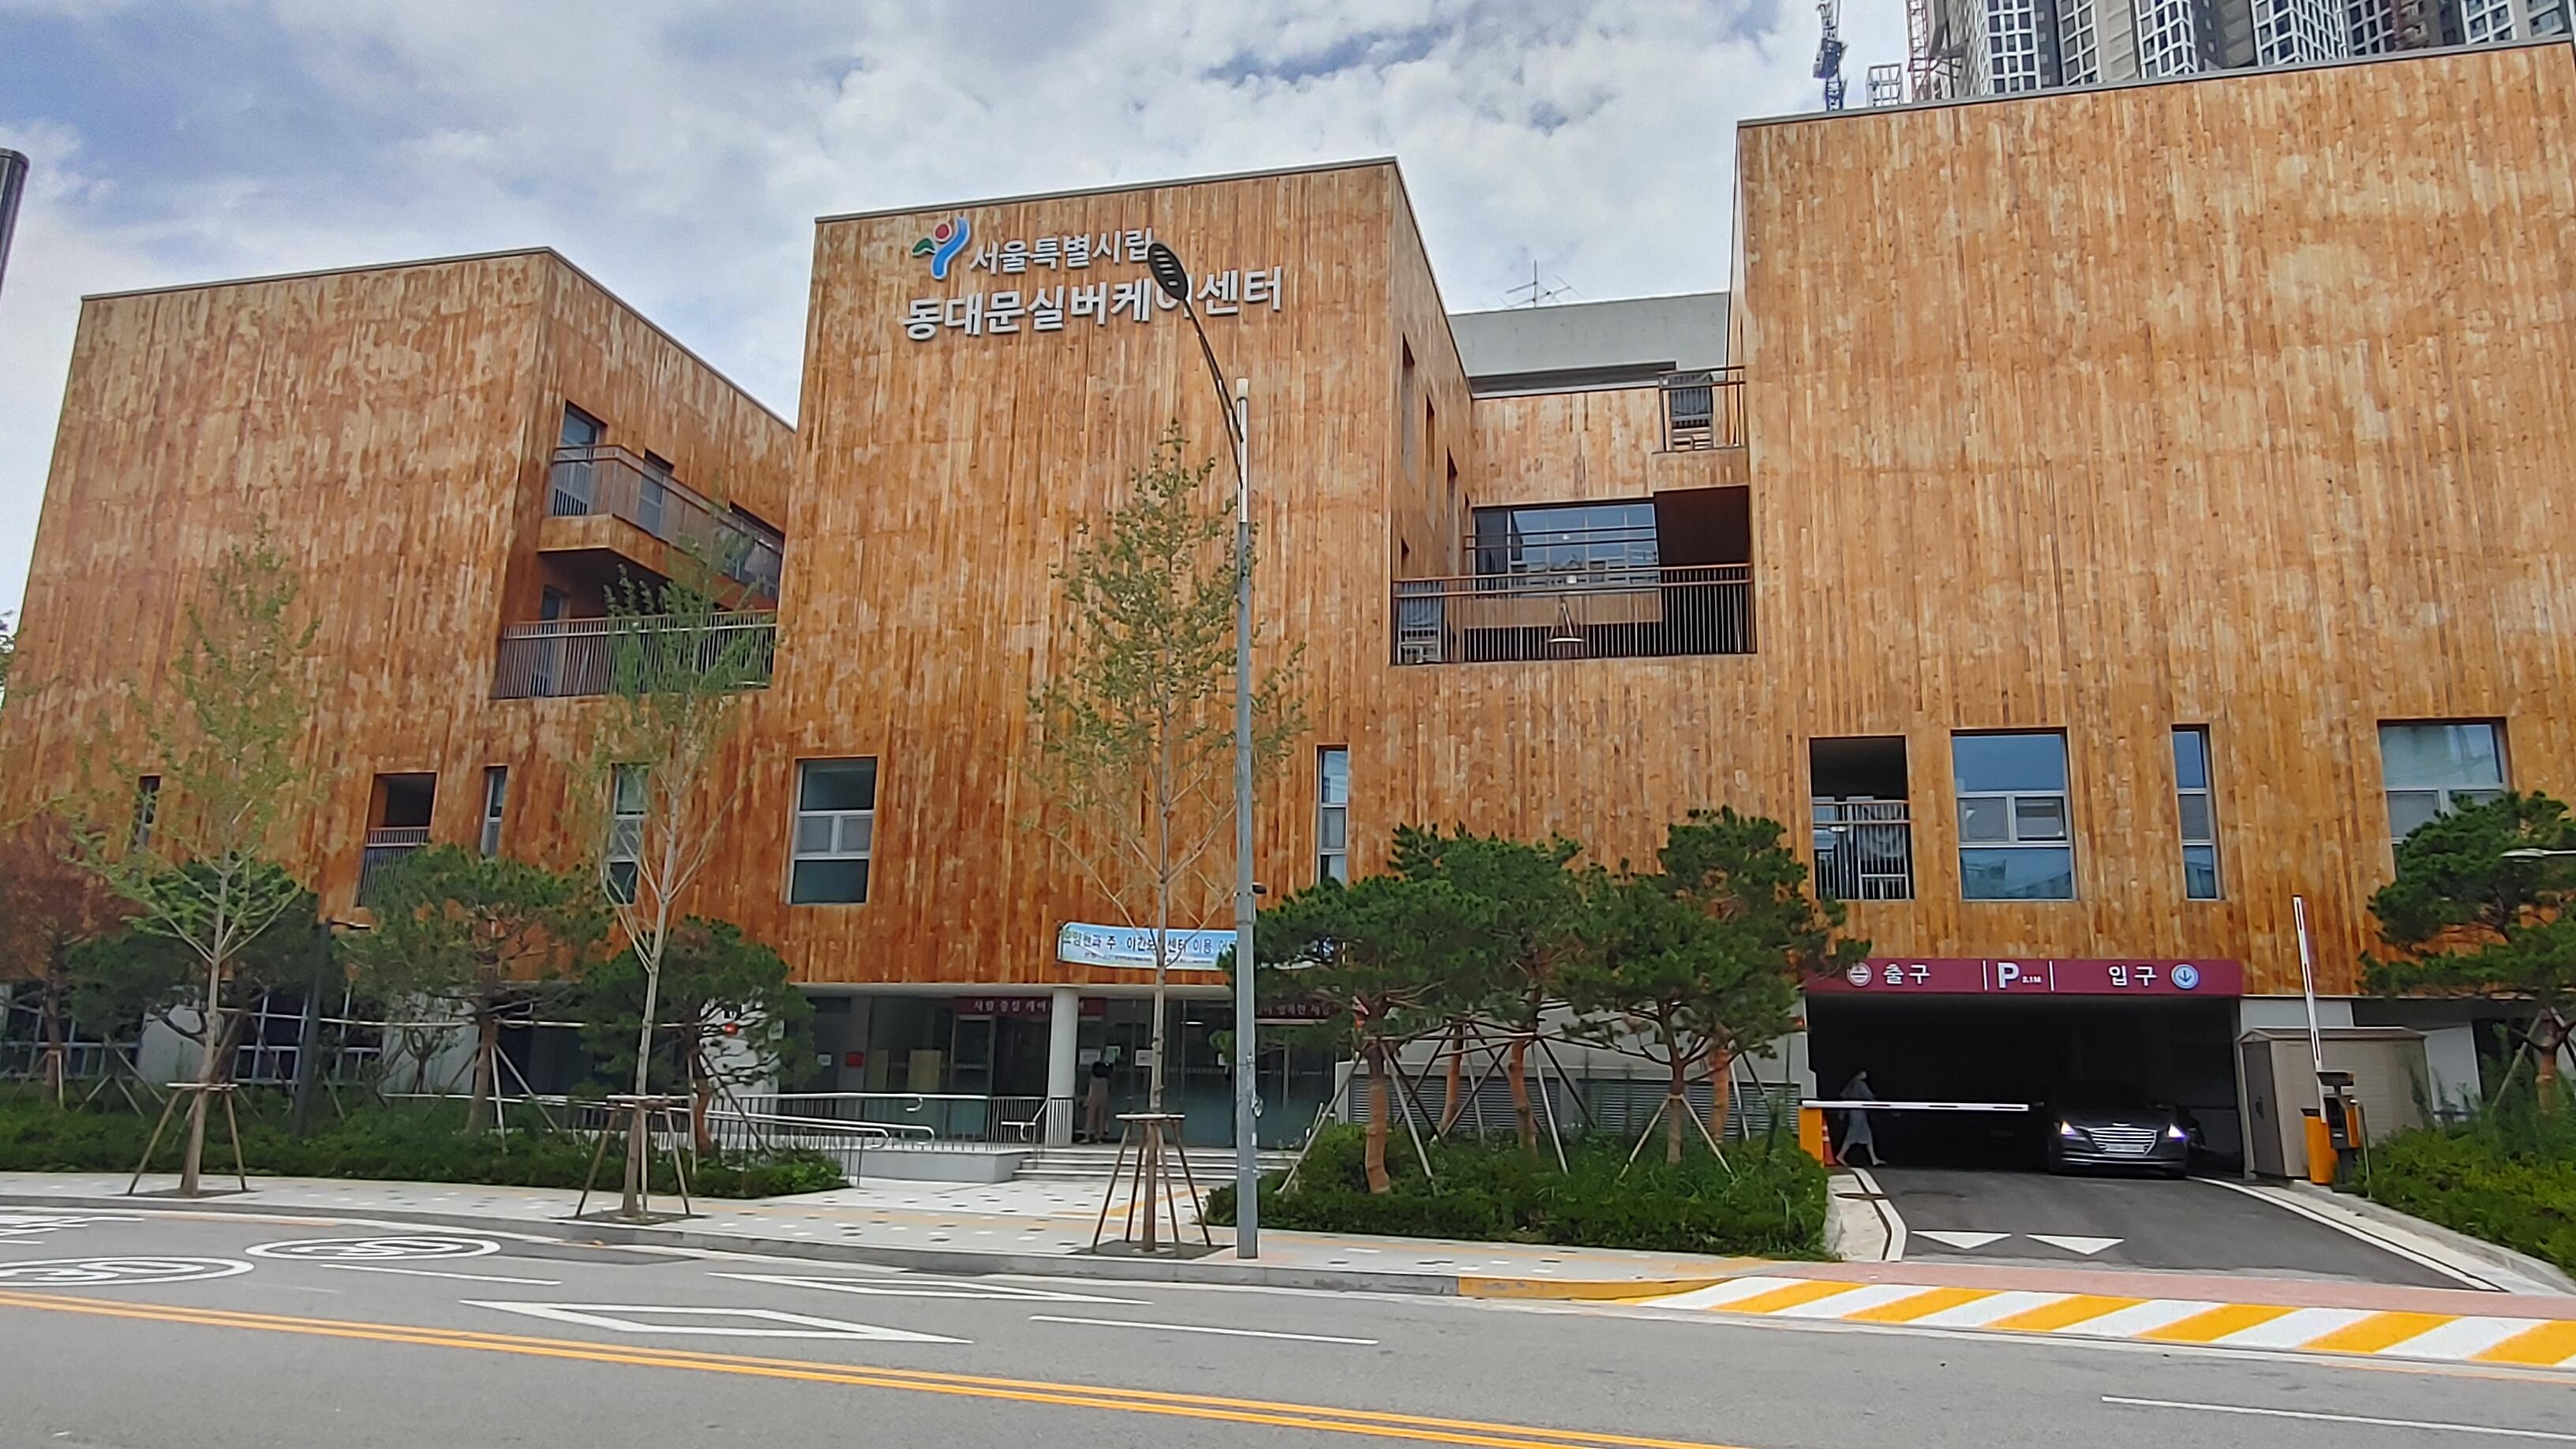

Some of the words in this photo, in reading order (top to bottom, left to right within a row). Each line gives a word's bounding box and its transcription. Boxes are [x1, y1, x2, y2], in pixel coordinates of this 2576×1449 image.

[970, 227, 1154, 275] 서울특별시립
[1883, 964, 1930, 984] 출구
[1998, 962, 2020, 988] P
[2108, 965, 2158, 987] 입구
